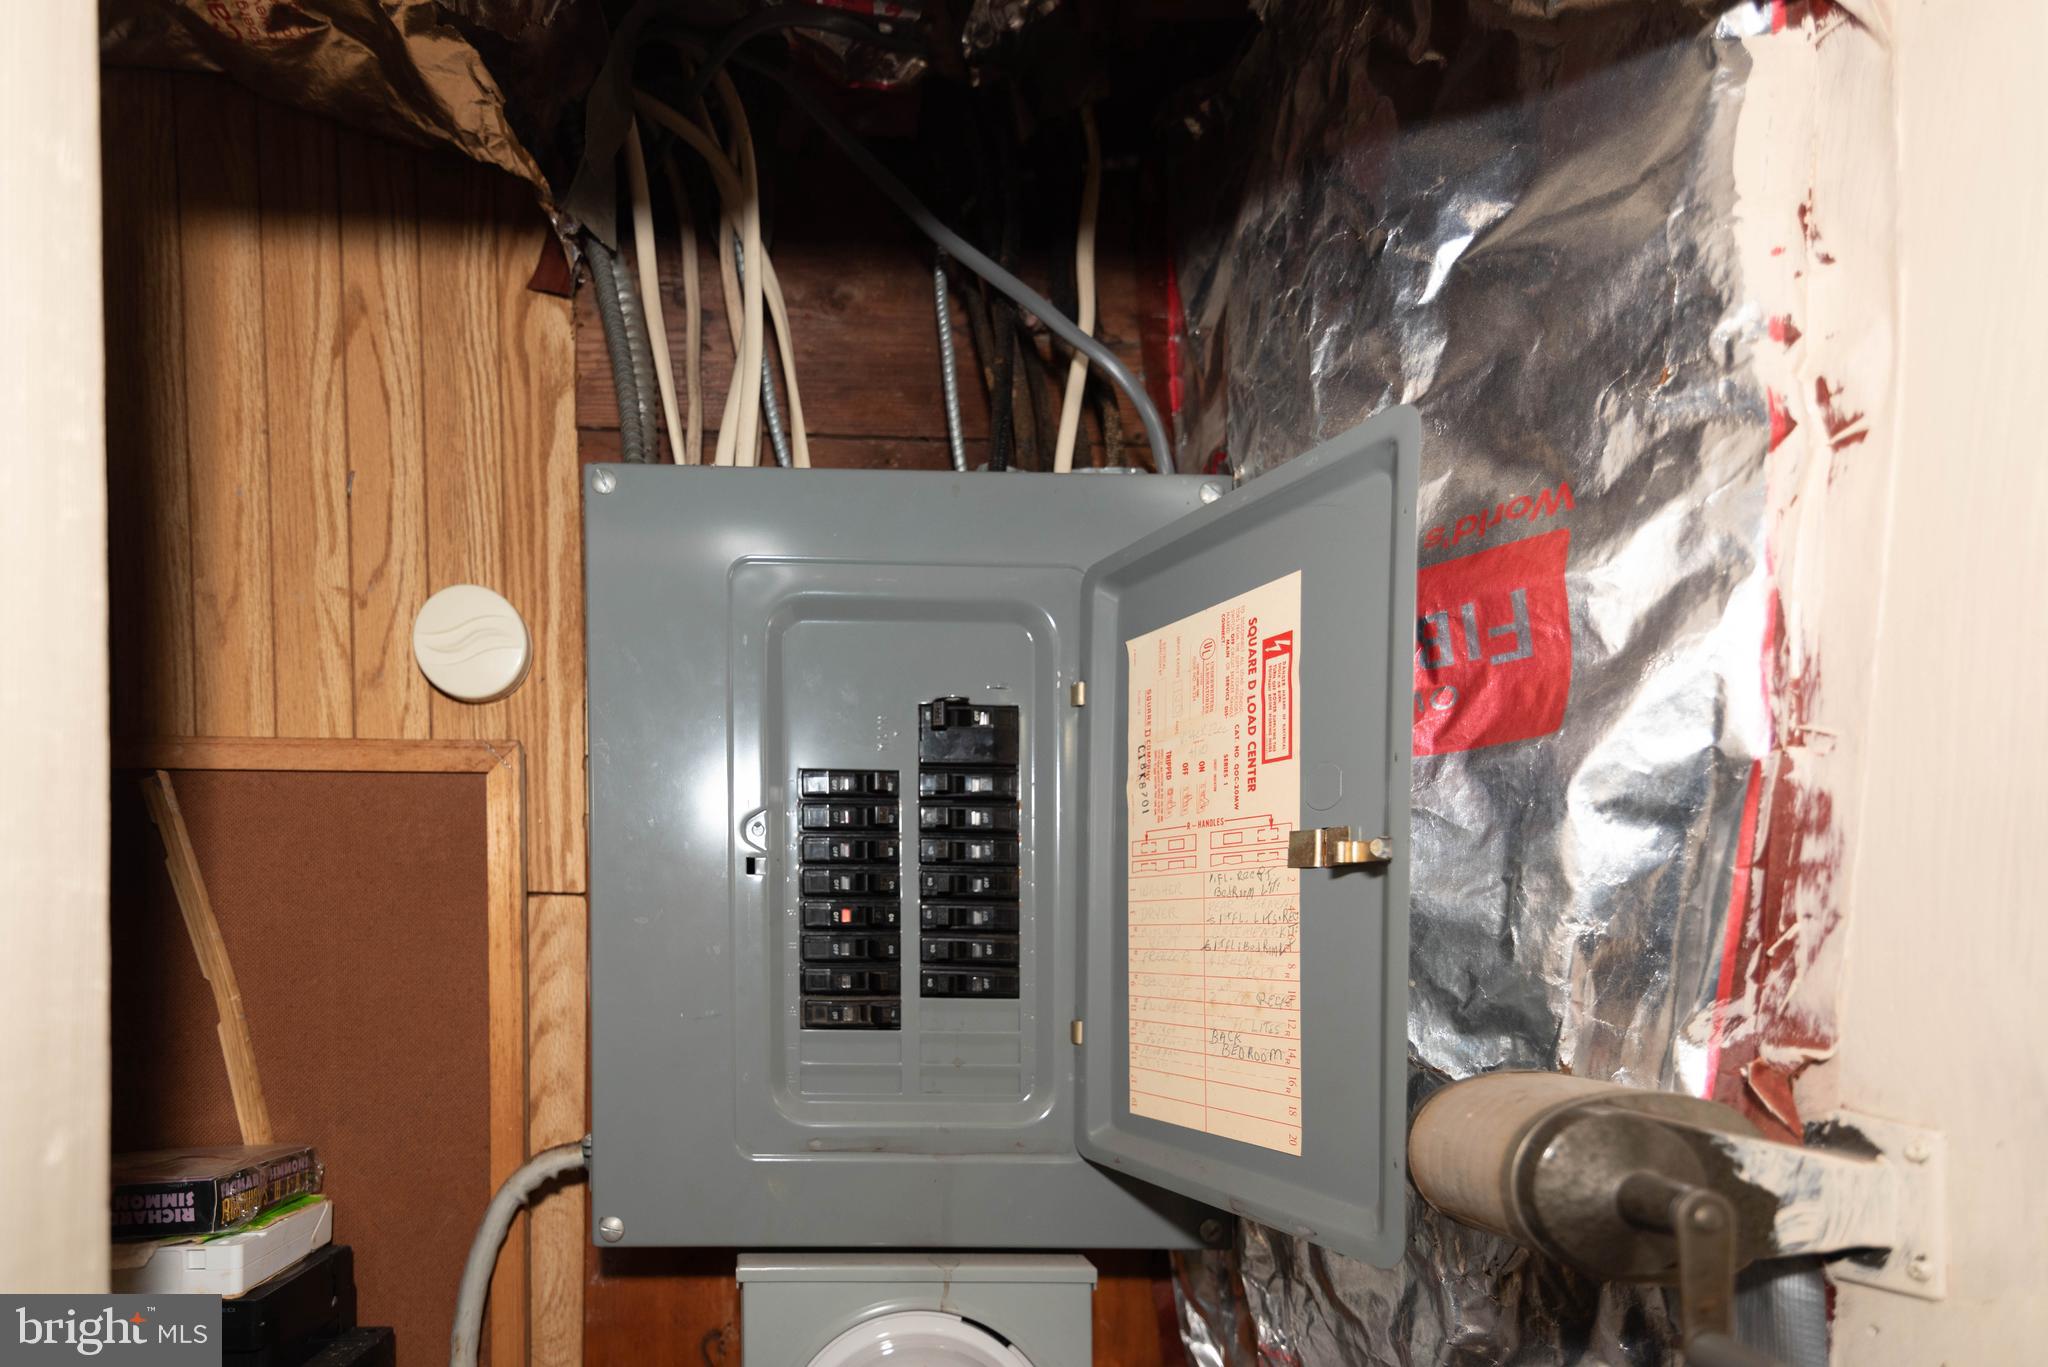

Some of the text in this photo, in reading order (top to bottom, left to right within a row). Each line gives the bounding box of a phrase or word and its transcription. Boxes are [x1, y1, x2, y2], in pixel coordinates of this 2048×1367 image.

[1424, 481, 1575, 549] World's
[1247, 617, 1258, 793] SQUARE D LOAD CENTER
[1165, 750, 1173, 781] TRIPPED
[1198, 760, 1206, 773] ON
[1287, 1019, 1297, 1029] 12
[1209, 1028, 1241, 1044] BACK
[1221, 1043, 1283, 1062] BEDROOM
[1287, 1048, 1296, 1058] 14
[1287, 1076, 1296, 1086] 16
[1288, 1106, 1297, 1116] 18
[1289, 1135, 1297, 1146] 20
